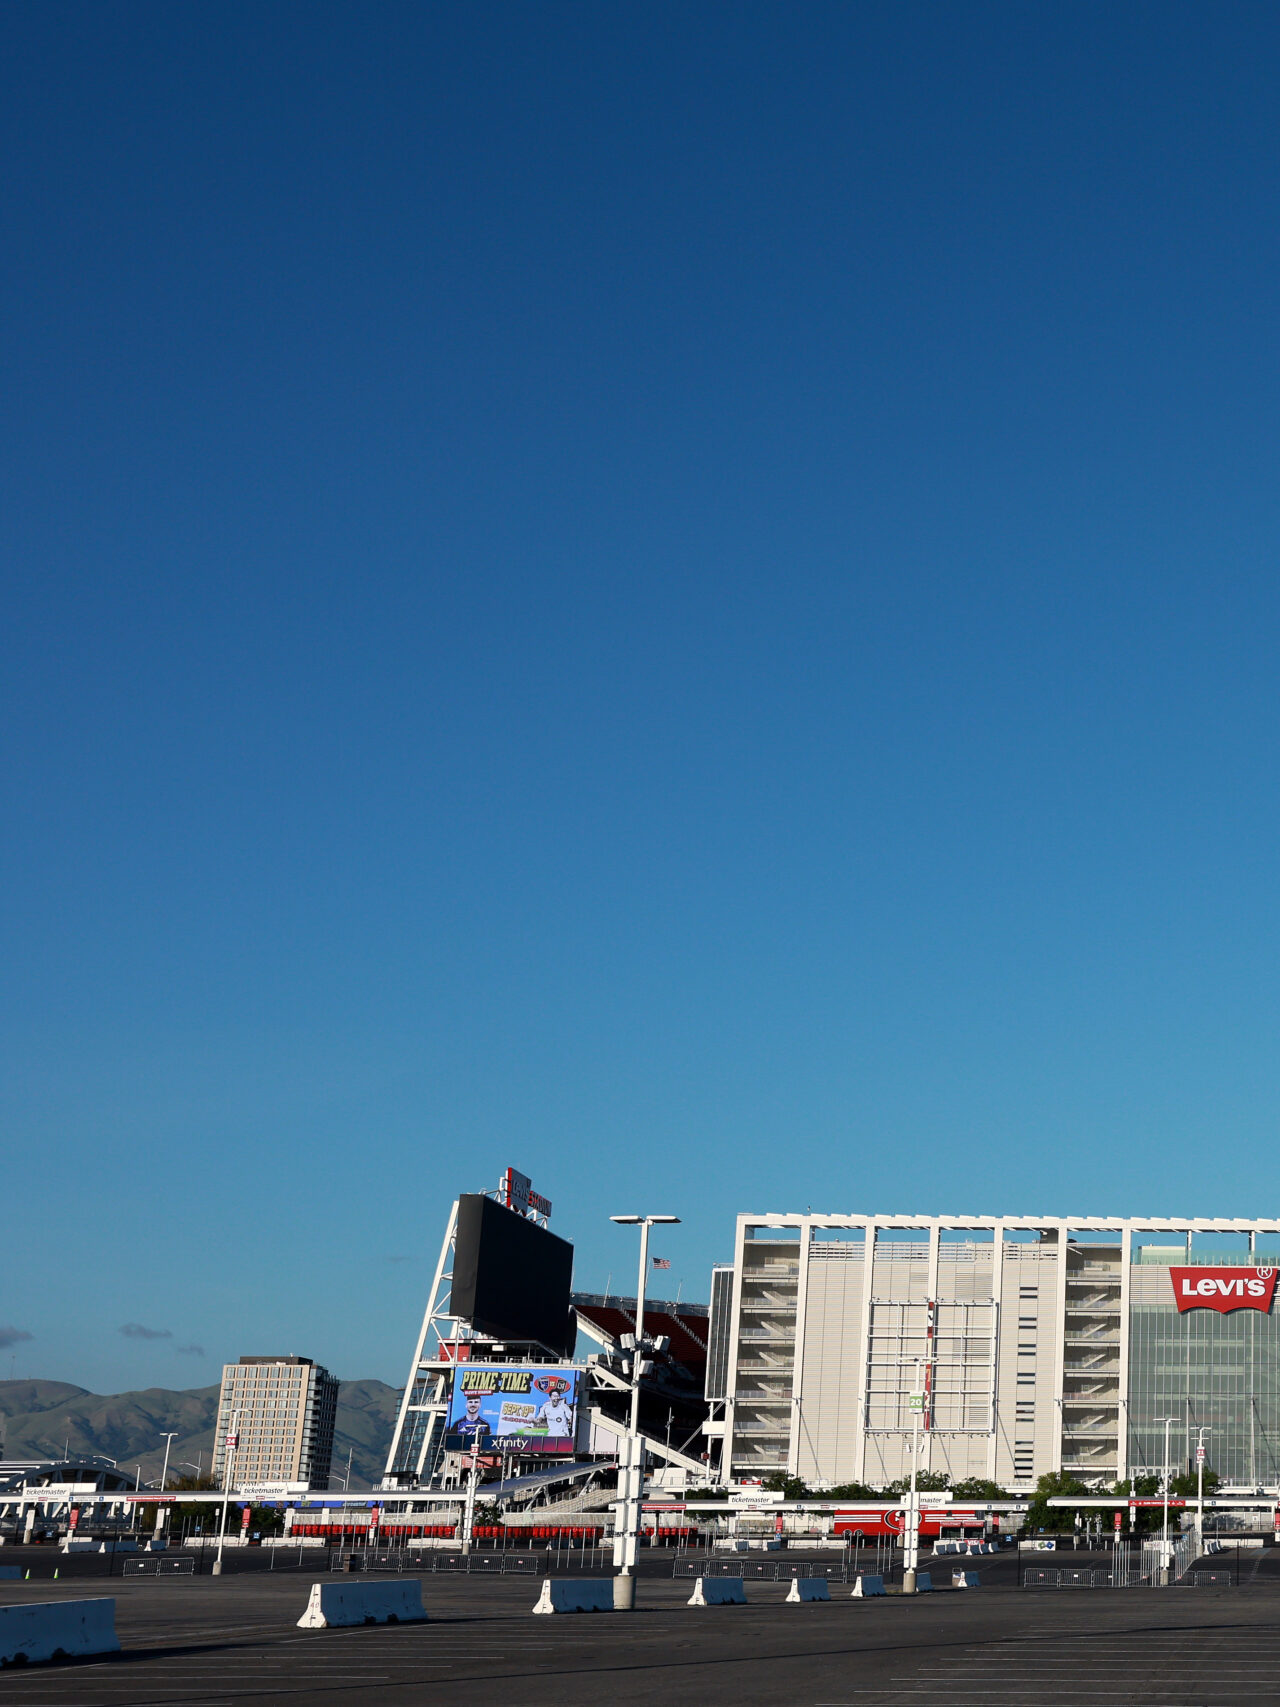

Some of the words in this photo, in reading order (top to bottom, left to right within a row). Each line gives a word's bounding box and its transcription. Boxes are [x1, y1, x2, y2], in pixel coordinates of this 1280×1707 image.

[460, 1371, 498, 1390] PRIME
[501, 1372, 530, 1391] TIME
[910, 1398, 922, 1406] 20
[226, 1437, 235, 1445] 24
[491, 1436, 528, 1450] xfinity
